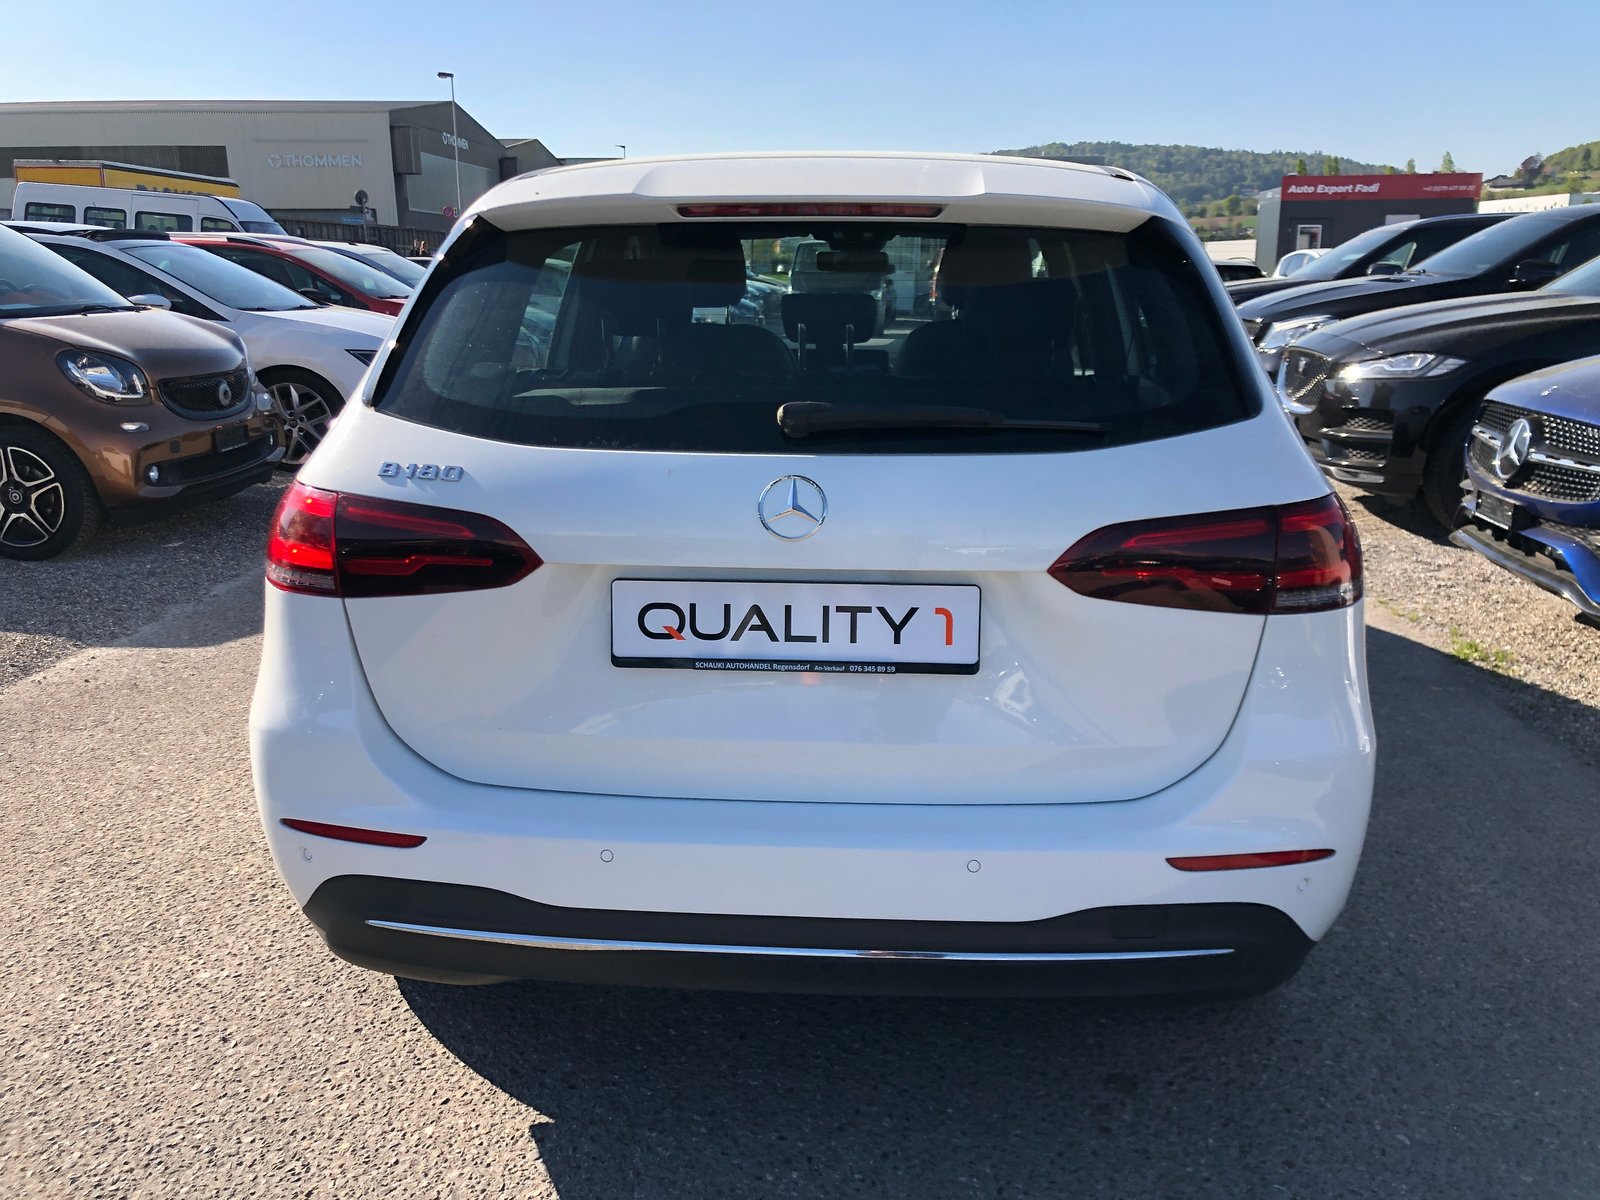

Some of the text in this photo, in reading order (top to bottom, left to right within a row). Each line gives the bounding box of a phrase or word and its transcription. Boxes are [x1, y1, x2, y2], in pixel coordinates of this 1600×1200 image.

[283, 154, 363, 168] THOMMEN
[1287, 184, 1315, 194] Auto
[1316, 184, 1354, 195] Export
[405, 463, 465, 483] 180
[637, 602, 954, 646] QUALITY 1
[695, 661, 725, 669] SCHAUKI
[725, 662, 772, 670] AUTOHANDEL
[772, 663, 811, 672] Regensdorf
[863, 665, 876, 673] 345
[877, 665, 886, 673] 89
